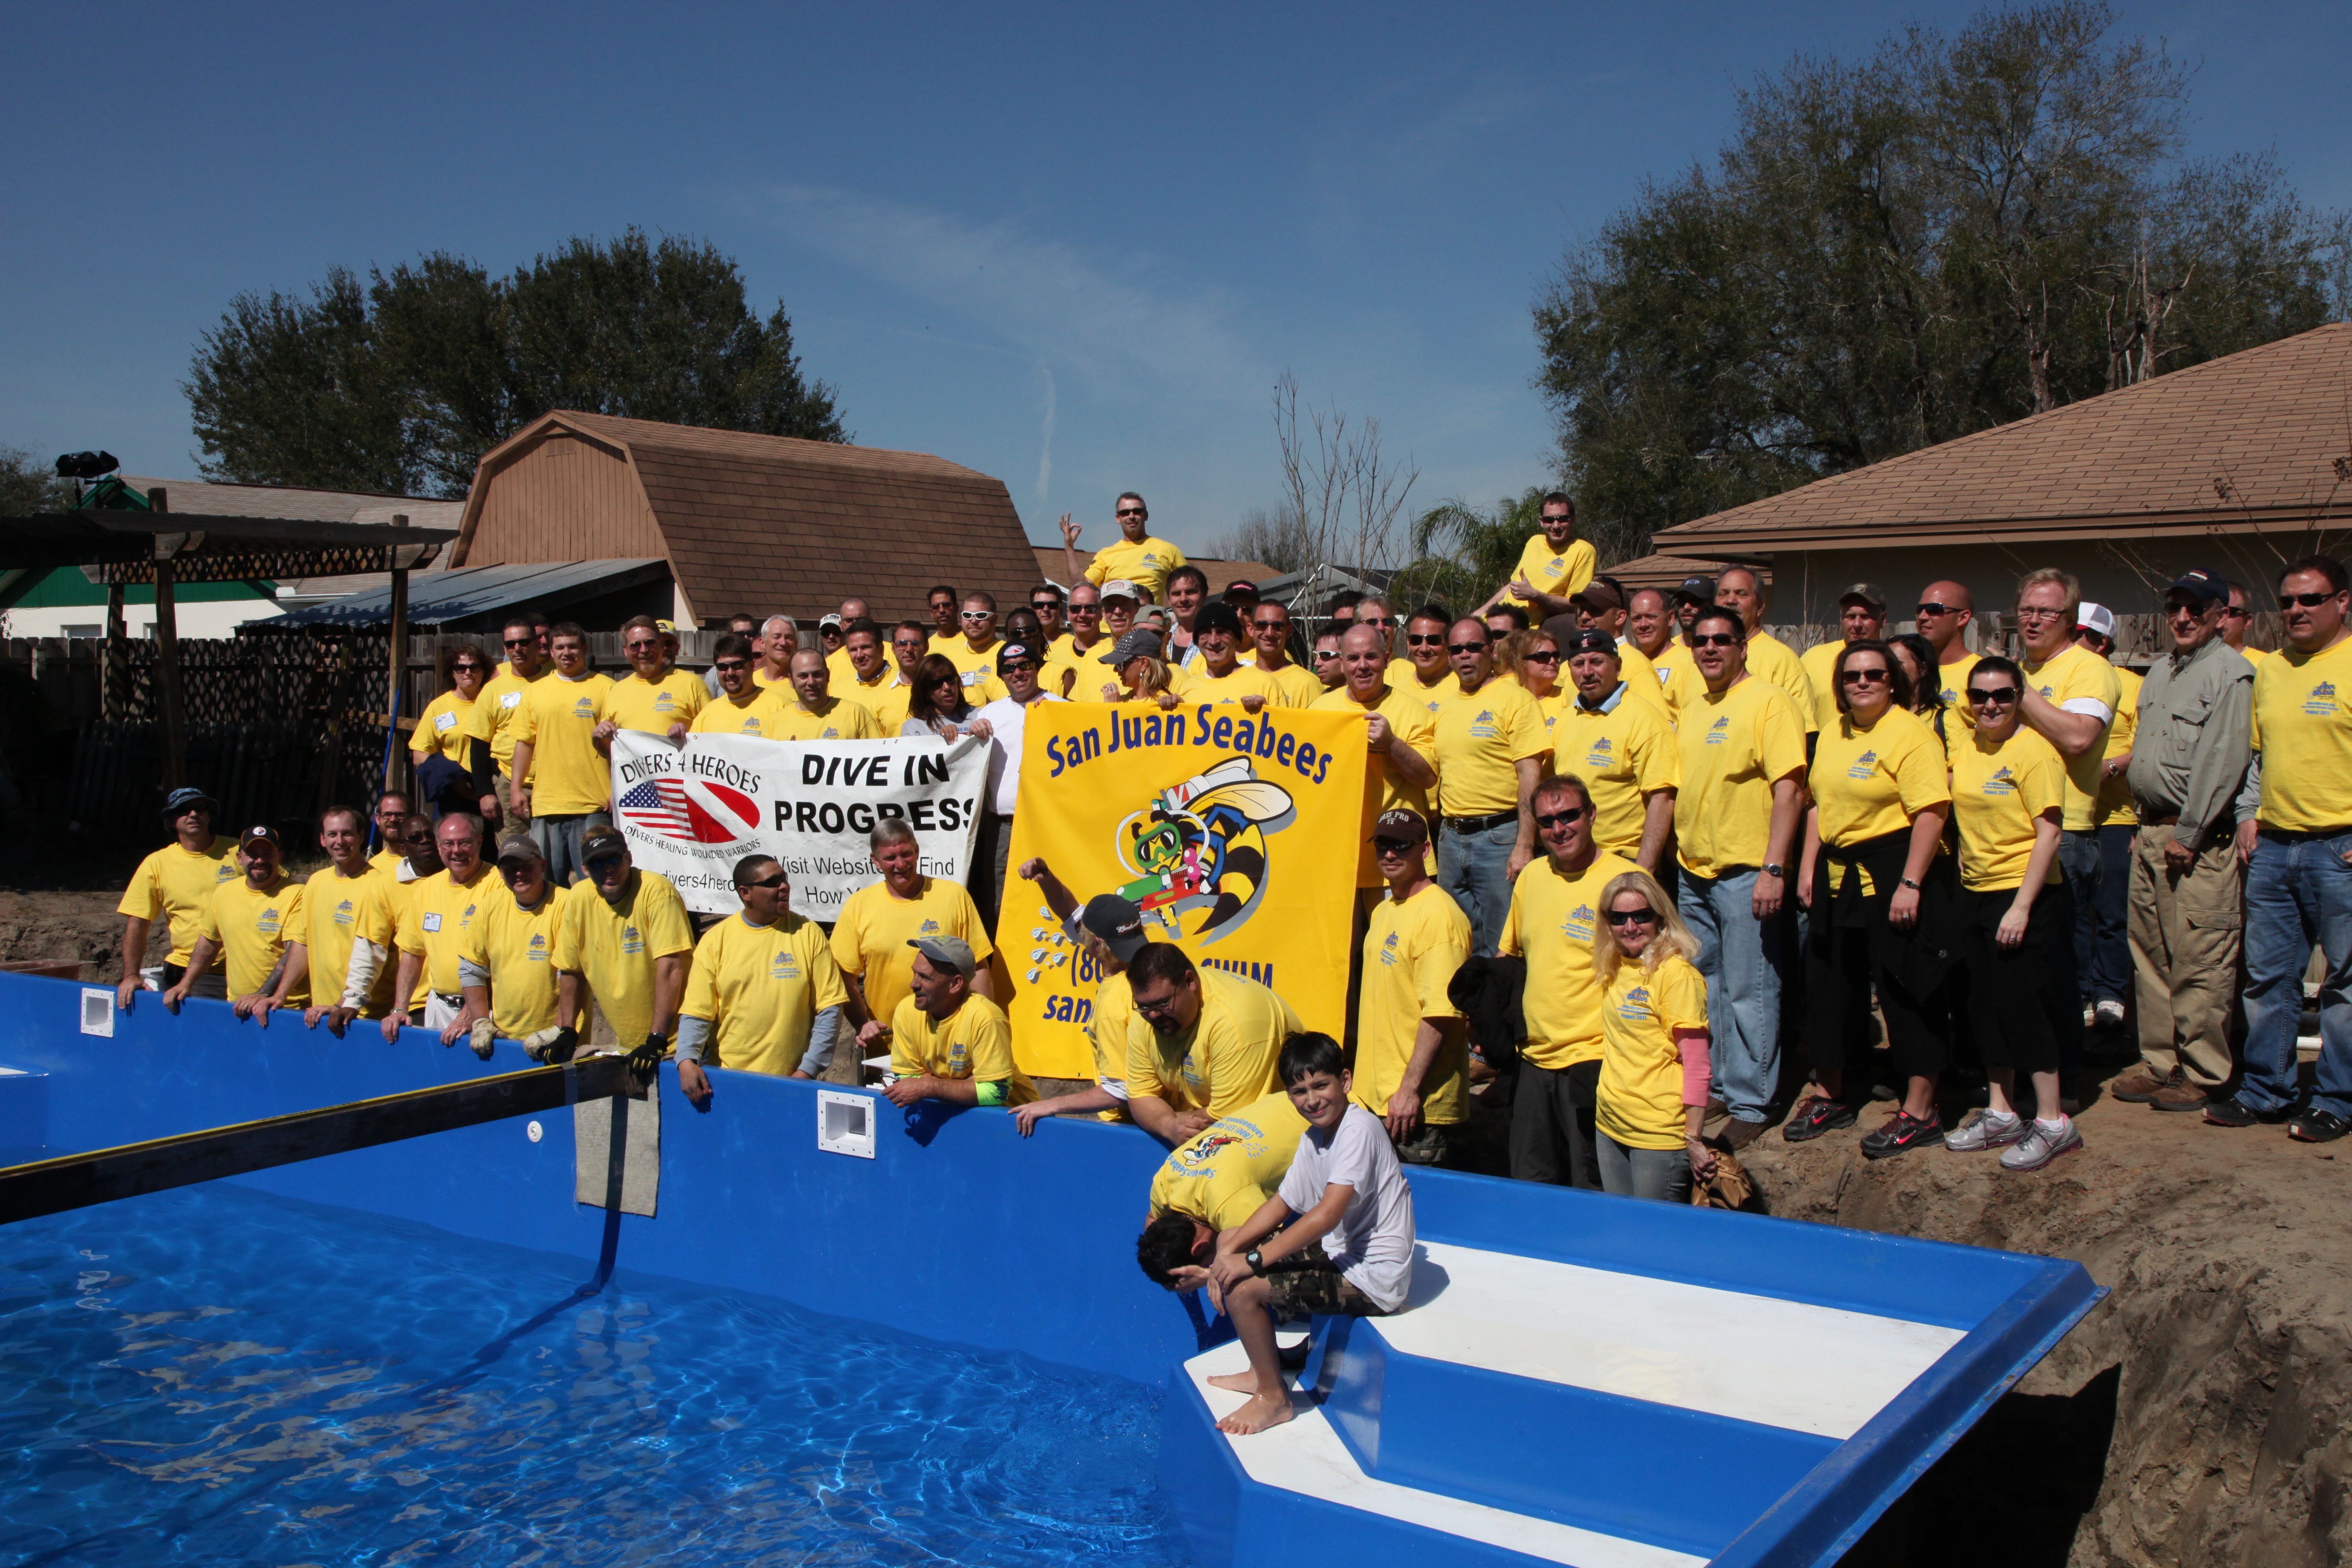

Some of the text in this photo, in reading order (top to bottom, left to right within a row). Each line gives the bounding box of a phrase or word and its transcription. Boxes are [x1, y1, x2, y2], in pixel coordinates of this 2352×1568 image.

[1047, 704, 1333, 784] San Juan Seabees
[620, 753, 761, 794] DIVERS 4 HEROES
[802, 753, 950, 786] DIVE IN
[1395, 811, 1409, 822] PRO
[624, 825, 654, 844] DIVERS
[655, 838, 688, 855] HEALING
[691, 848, 724, 859] WOUNDED
[725, 838, 761, 858] WARRIORS
[774, 856, 810, 874] Visit
[920, 856, 954, 875] Find
[805, 886, 842, 904] How
